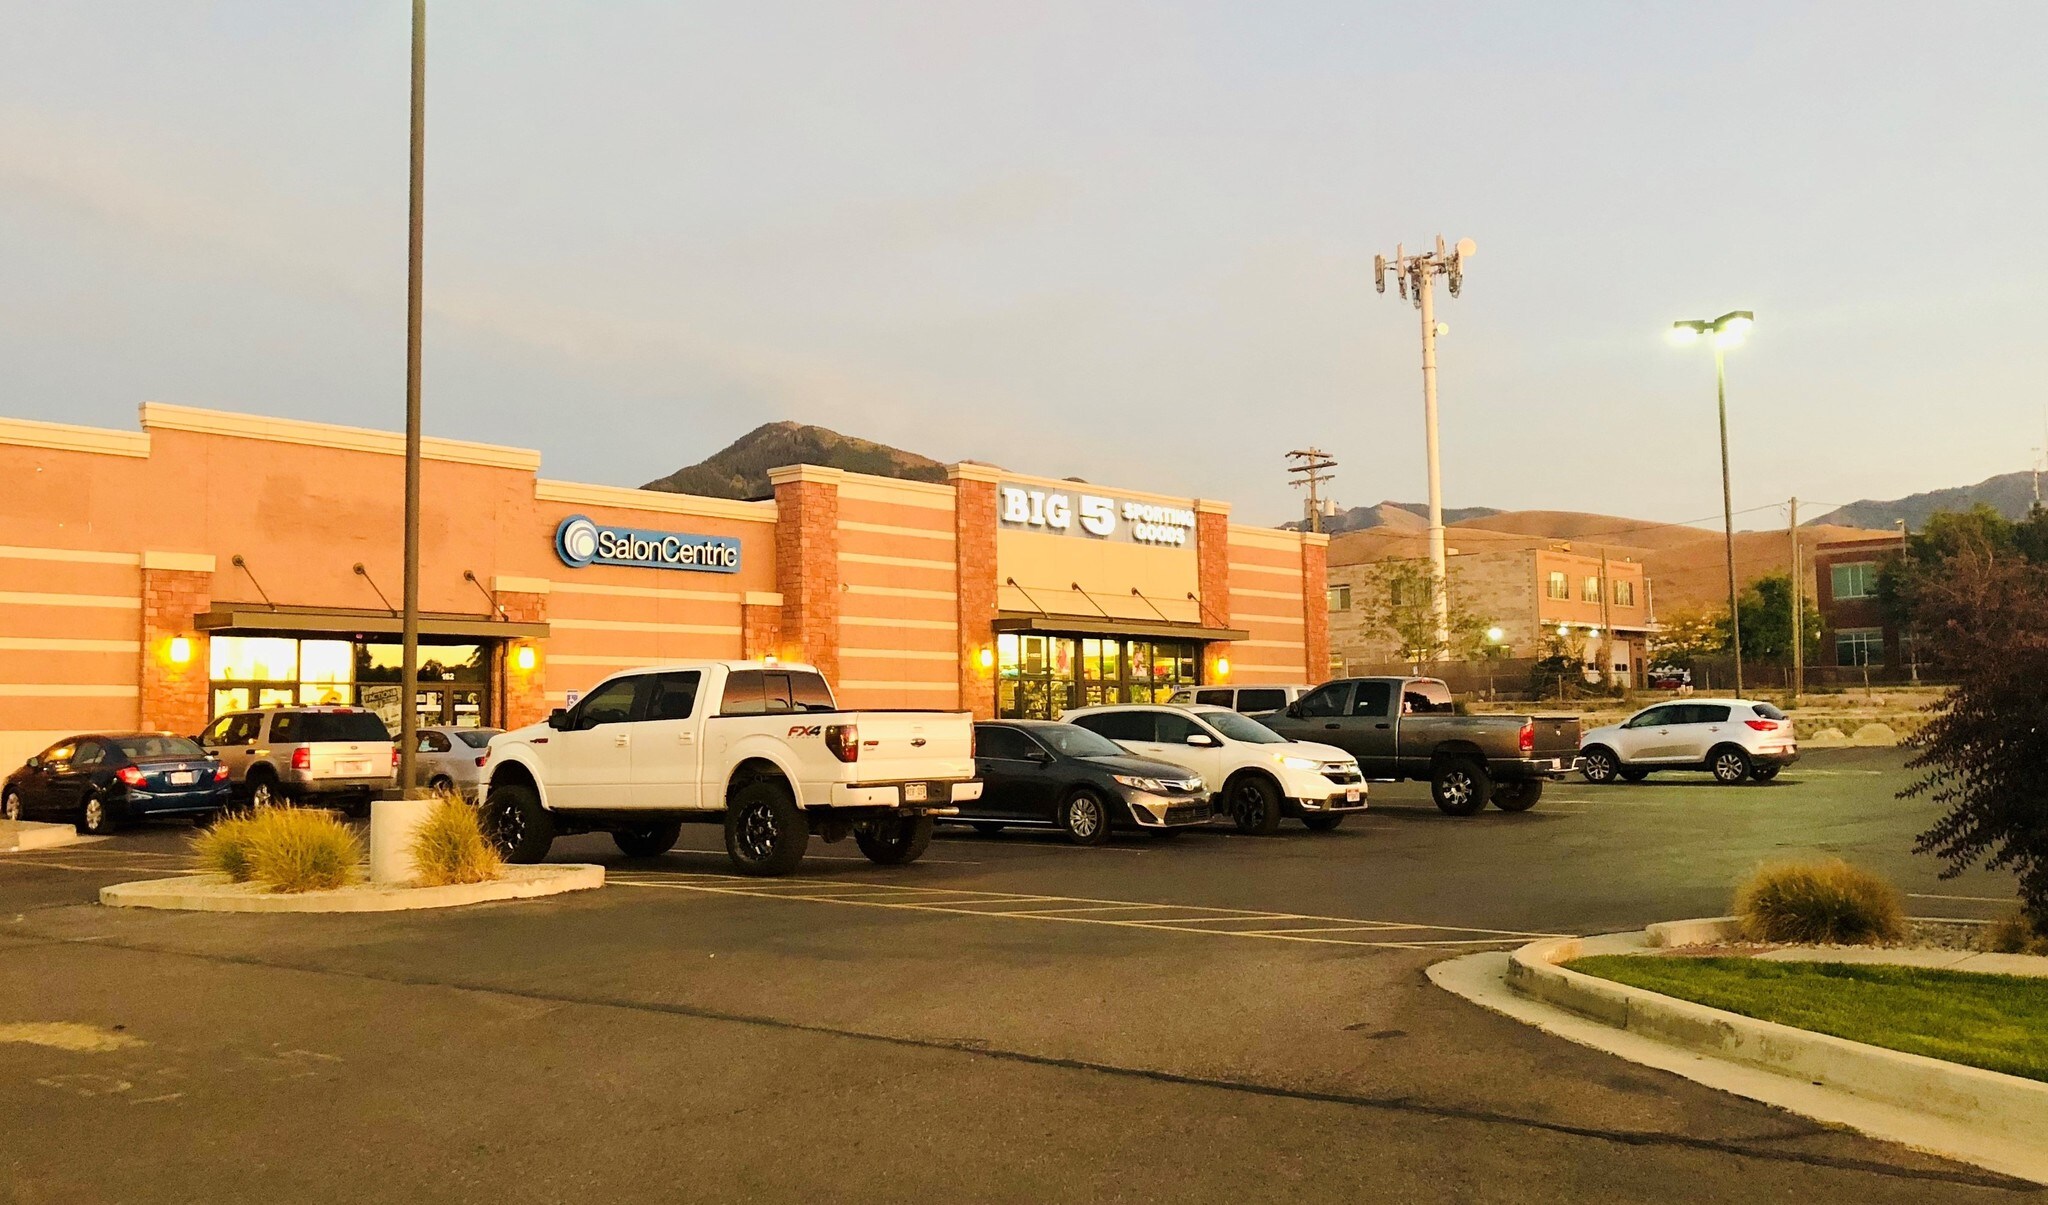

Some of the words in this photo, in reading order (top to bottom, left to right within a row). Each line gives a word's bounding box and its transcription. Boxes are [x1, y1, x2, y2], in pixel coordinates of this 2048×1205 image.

[1002, 488, 1071, 528] BIG
[1081, 495, 1116, 536] 5
[1122, 502, 1195, 527] SPORTING
[1133, 523, 1186, 545] GOODS
[599, 530, 738, 567] SalonCentric
[788, 725, 821, 737] FX4
